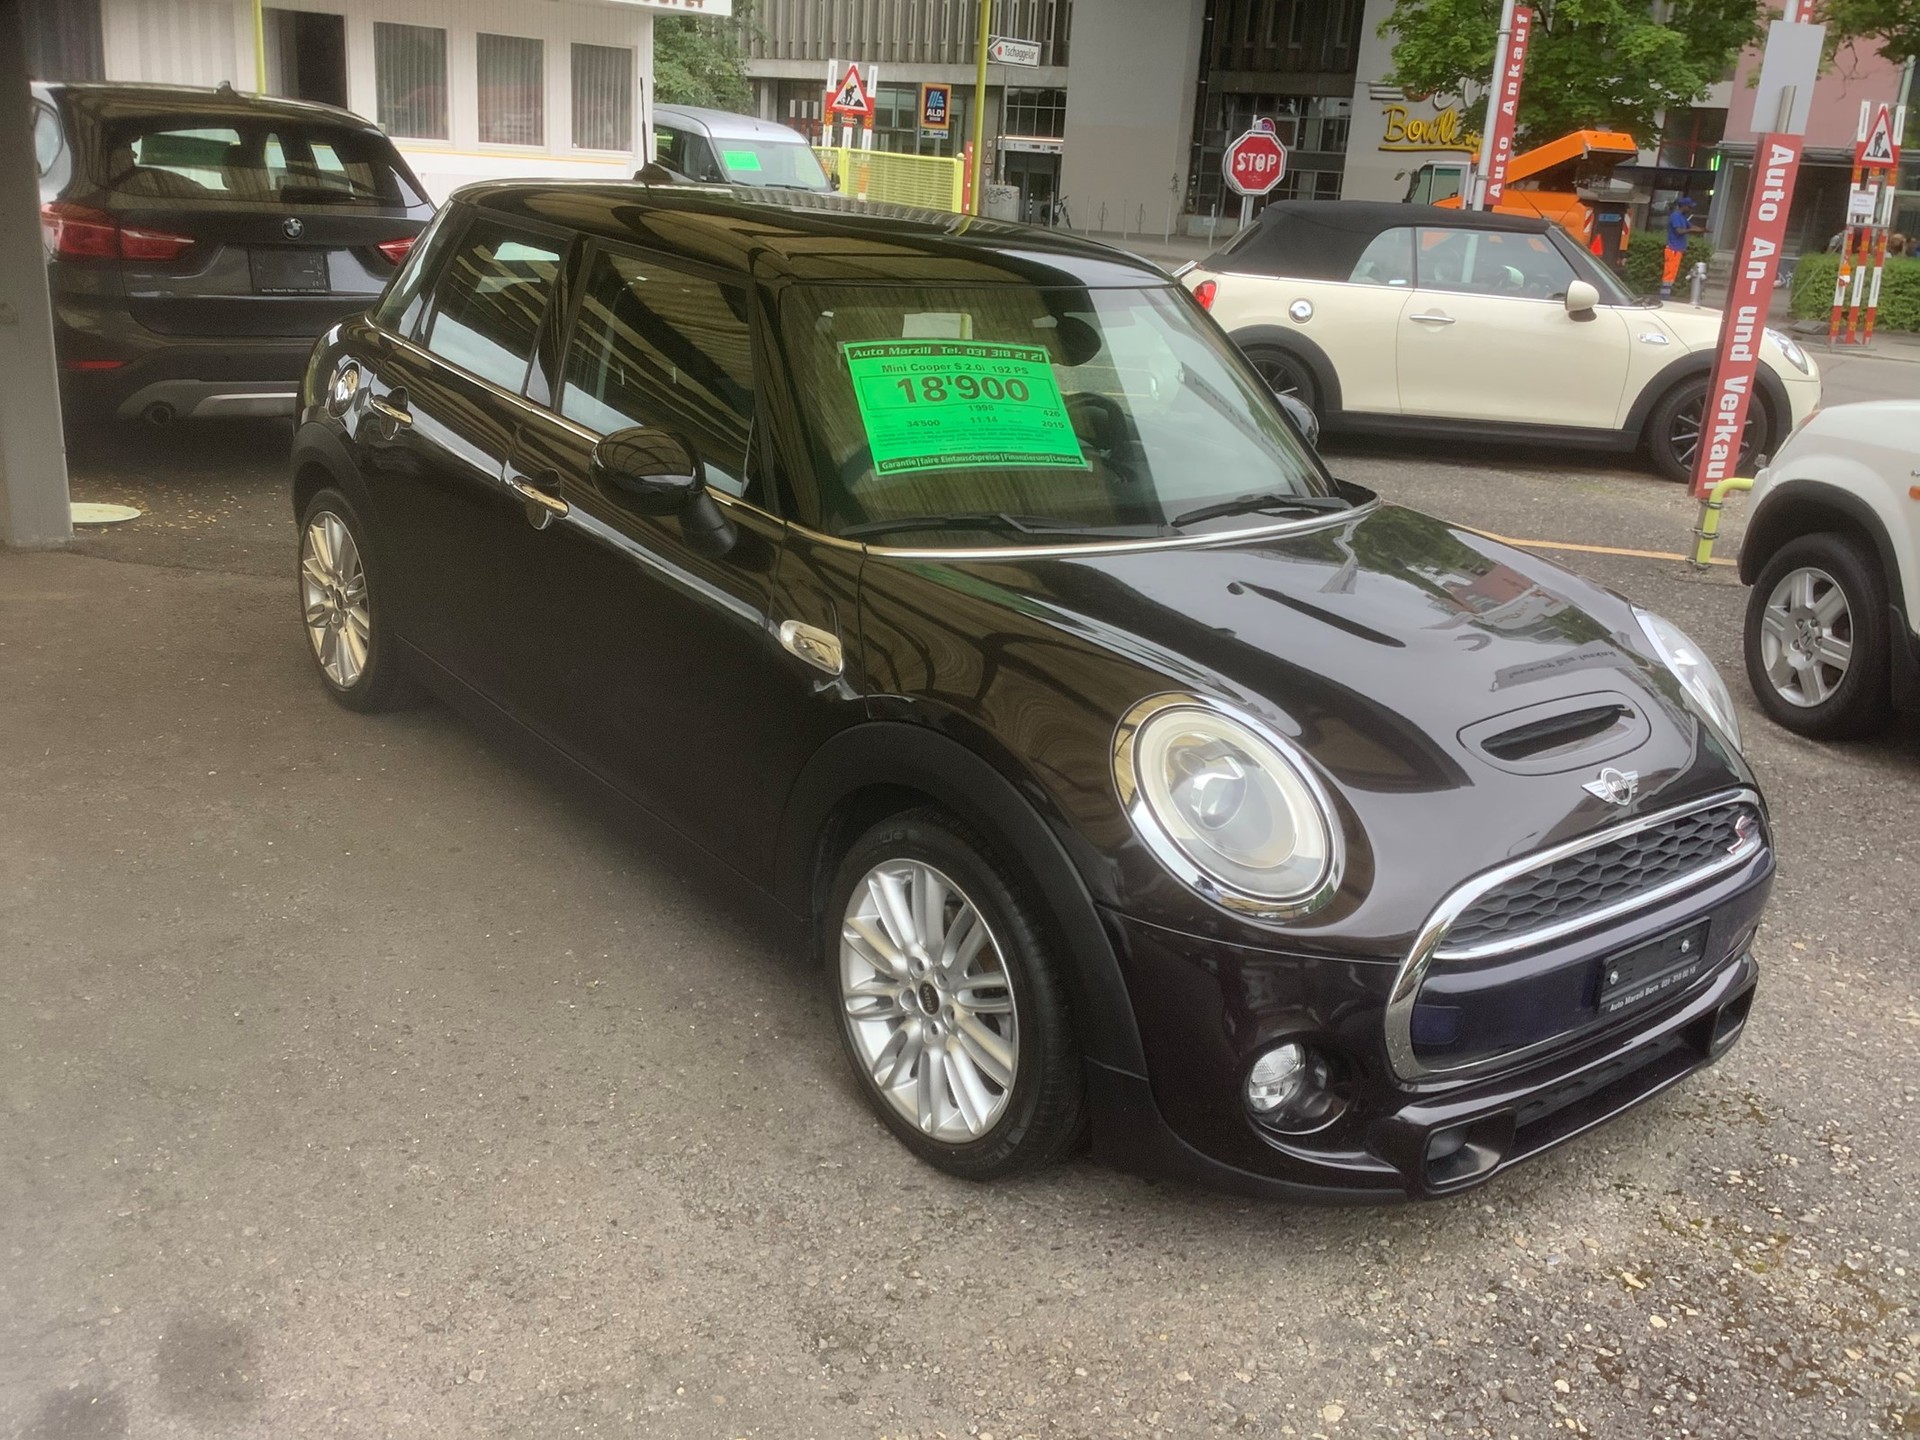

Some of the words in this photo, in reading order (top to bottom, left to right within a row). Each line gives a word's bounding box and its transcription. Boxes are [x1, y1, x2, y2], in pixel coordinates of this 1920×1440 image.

[926, 108, 946, 118] ALDI
[1489, 136, 1509, 198] Auto
[1502, 13, 1529, 116] Ankauf
[1236, 152, 1278, 173] STOP
[1757, 143, 1795, 222] Auto
[1745, 236, 1776, 295] An-
[1729, 306, 1758, 362] und
[853, 348, 885, 358] Auto
[941, 346, 962, 354] Tel.
[966, 348, 986, 356] 031
[1015, 351, 1026, 359] 21
[1030, 353, 1043, 361] 21
[881, 364, 907, 373] Mini
[910, 363, 951, 371] Cooper
[954, 362, 962, 370] S
[992, 365, 1011, 373] 192
[1014, 366, 1029, 374] PS
[897, 374, 1030, 404] 18'900
